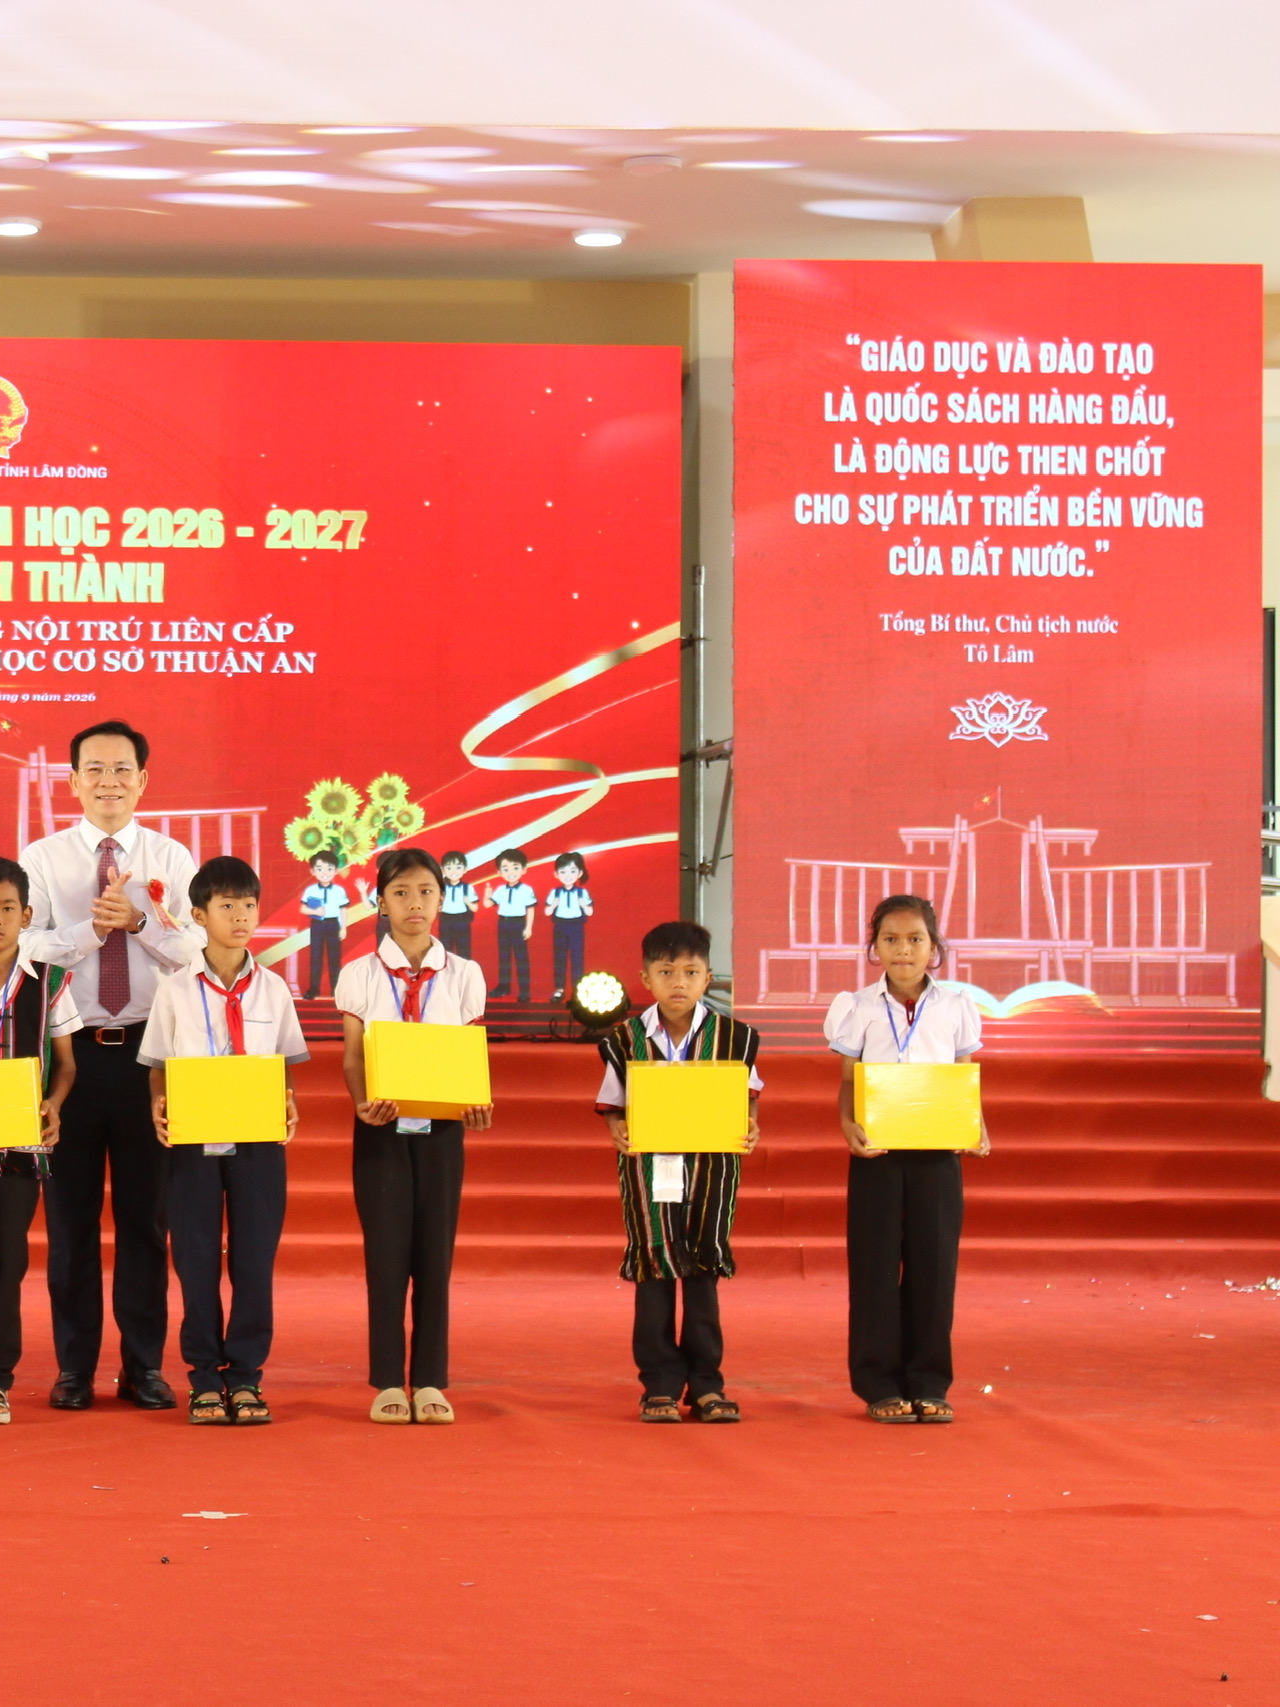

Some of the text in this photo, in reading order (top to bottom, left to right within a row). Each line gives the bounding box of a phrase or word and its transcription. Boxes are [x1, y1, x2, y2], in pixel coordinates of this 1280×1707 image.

[934, 341, 988, 379] DỤC
[996, 337, 1031, 373] VÀ
[1038, 337, 1094, 374] ĐÀO
[1102, 343, 1153, 381] TẠO
[825, 382, 1174, 430] LÀ QUỐC SÁCH HÀNG ĐẦU,
[33, 463, 63, 478] LÂM
[834, 436, 1165, 481] LÀ ĐỘNG LỰC THEN CHỐT
[795, 485, 1203, 531] CHO SỰ PHÁT TRIỂN BỀN VỮNG
[24, 506, 110, 555] HỌC
[121, 507, 225, 548] 2026
[236, 526, 254, 538] -
[265, 509, 368, 550] 2027
[889, 536, 944, 576] CỦA
[951, 537, 1003, 576] ĐẤT
[23, 553, 164, 603] THÀNH
[12, 615, 70, 645] NỘI
[77, 616, 143, 642] TRÚ
[151, 617, 225, 643] LIÊN
[233, 613, 294, 643] CẤP
[880, 611, 1118, 638] Tổng Bí thư, Chủ tịch nước
[53, 649, 96, 672] CƠ
[151, 648, 265, 677] THUẬN
[270, 652, 316, 674] AN
[964, 643, 1034, 664] Tô Lâm
[22, 693, 30, 703] 9
[64, 692, 96, 702] 2026
